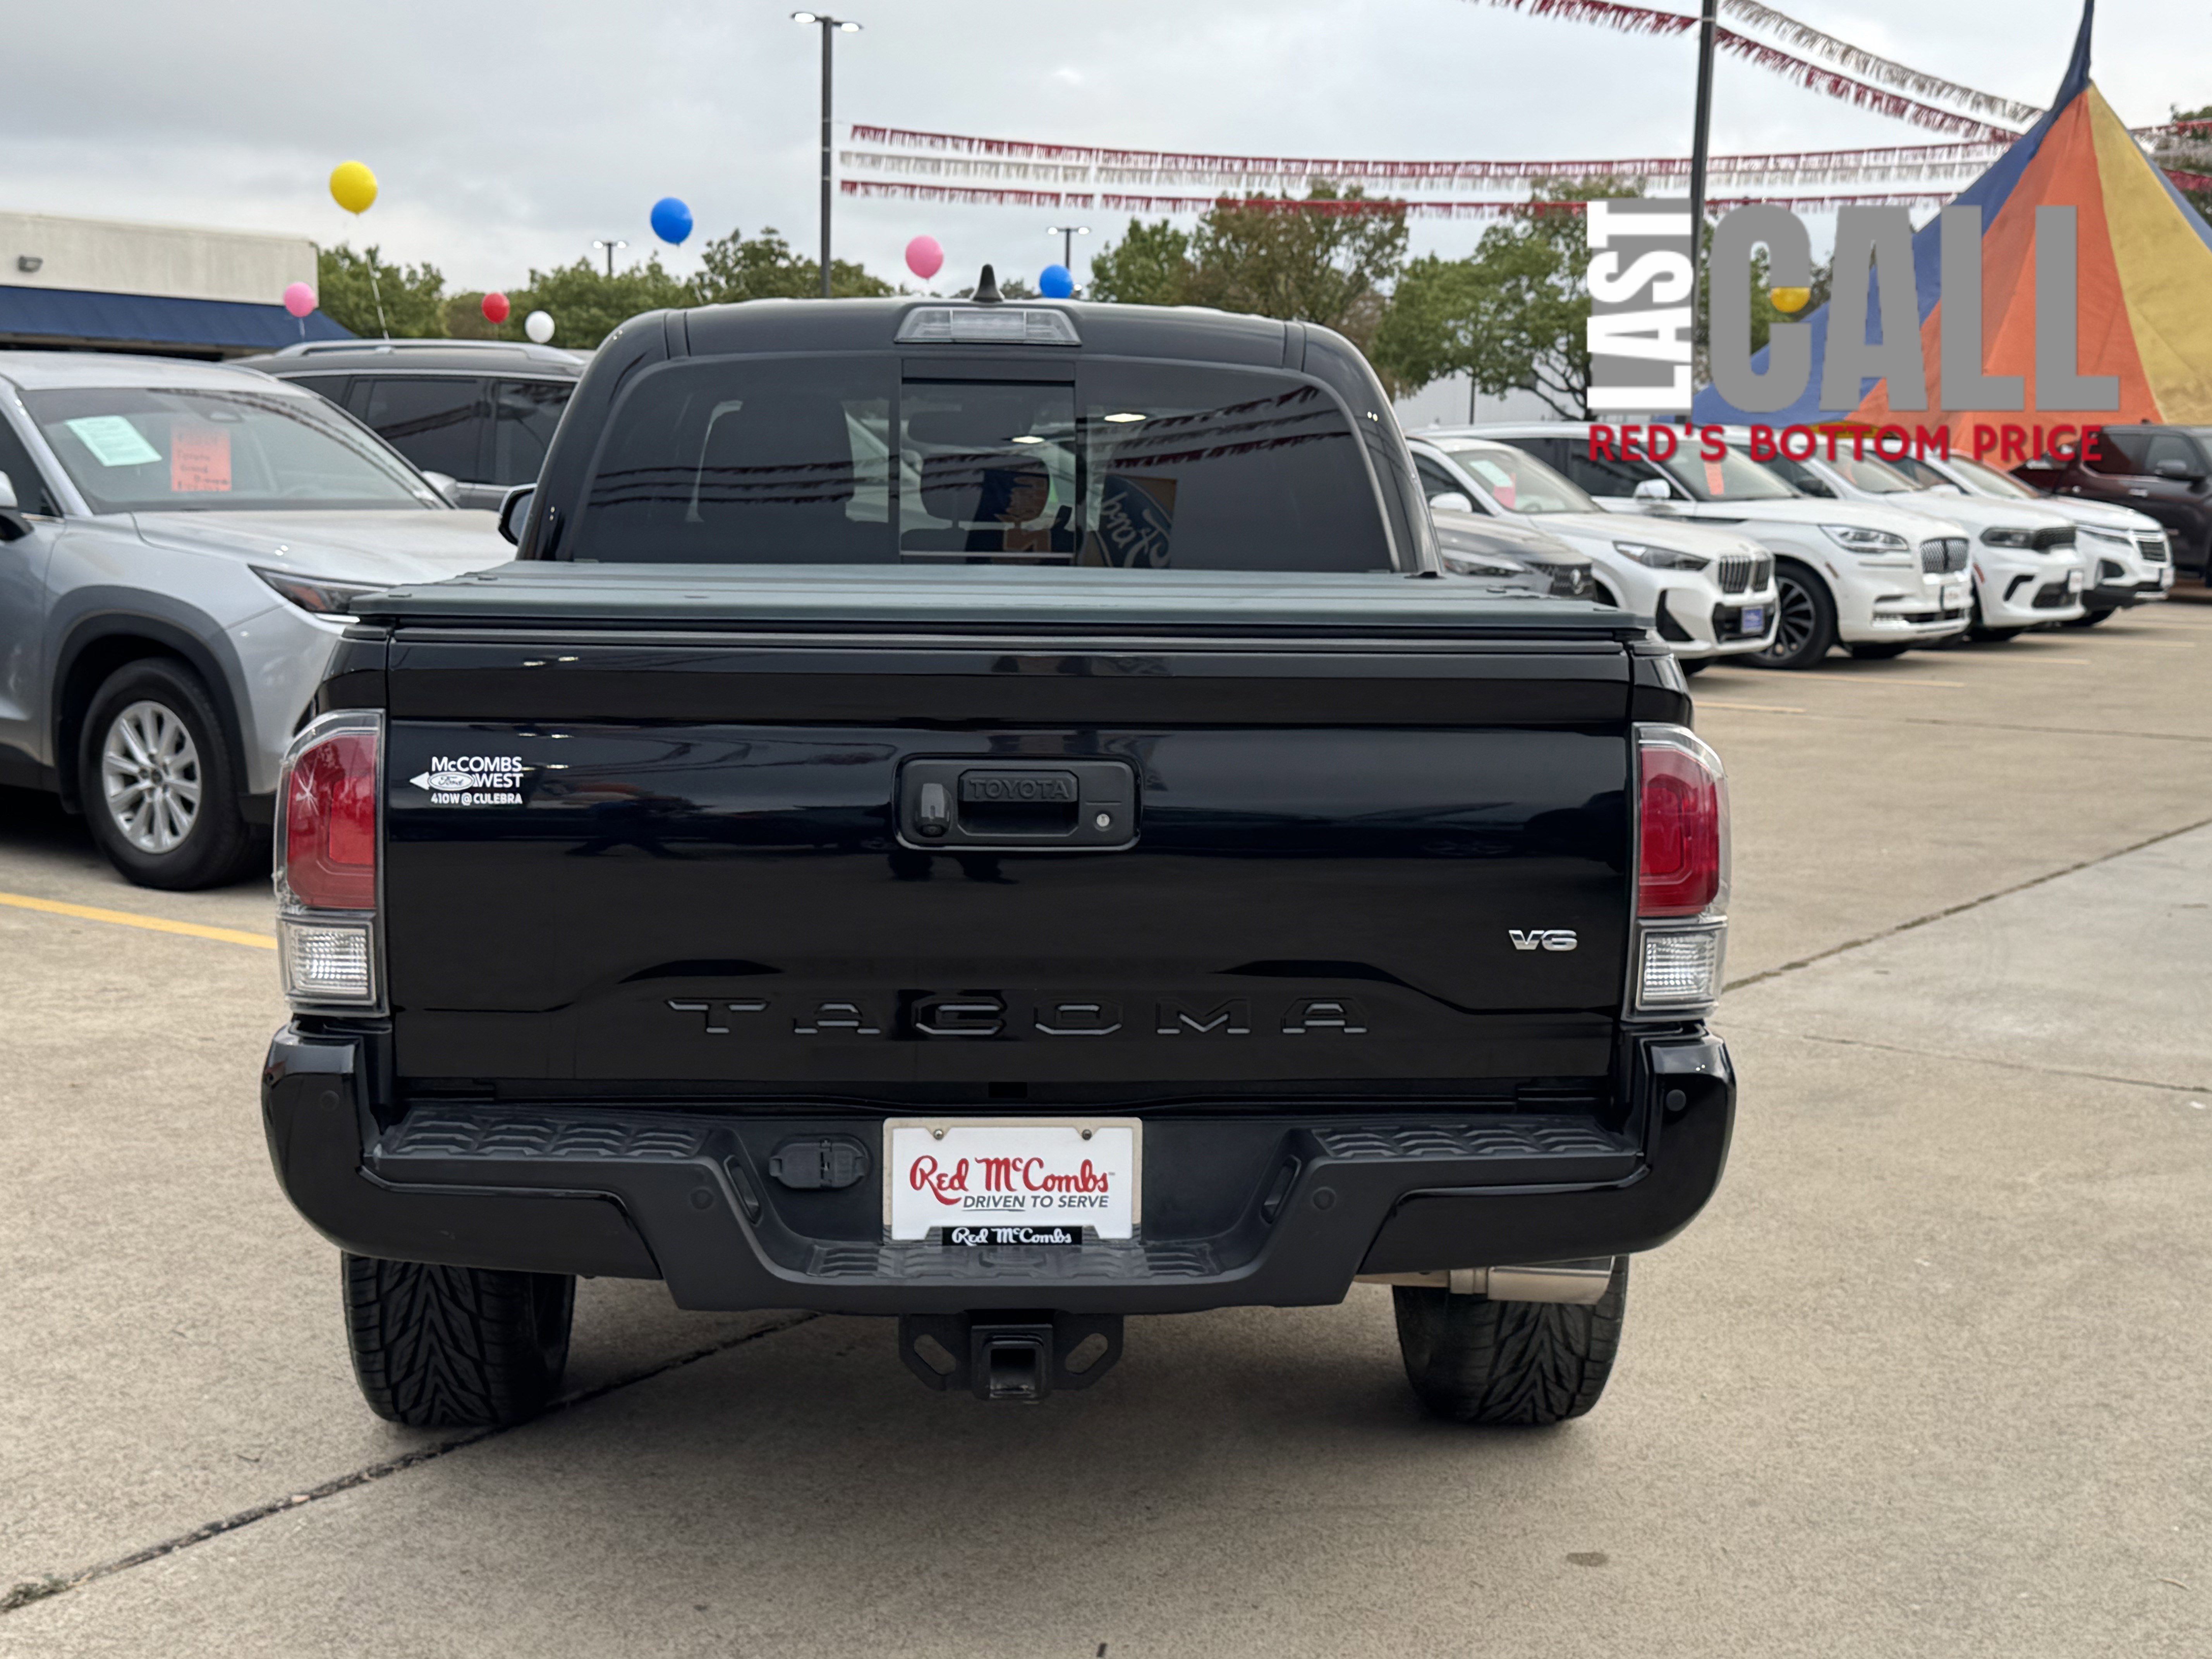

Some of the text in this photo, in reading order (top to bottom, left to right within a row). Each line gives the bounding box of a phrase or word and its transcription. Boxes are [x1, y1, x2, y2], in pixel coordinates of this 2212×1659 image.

[431, 756, 523, 772] McCOMBS
[477, 773, 524, 788] WEST
[970, 779, 1069, 799] TOYOTA
[473, 793, 523, 804] CULEBRA
[1508, 930, 1578, 951] V6
[665, 996, 1369, 1036] TACOMA
[910, 1155, 1108, 1205] Red McCombs
[963, 1195, 1109, 1208] DRIVEN TO SERVE
[951, 1227, 1072, 1246] Red McCombs
